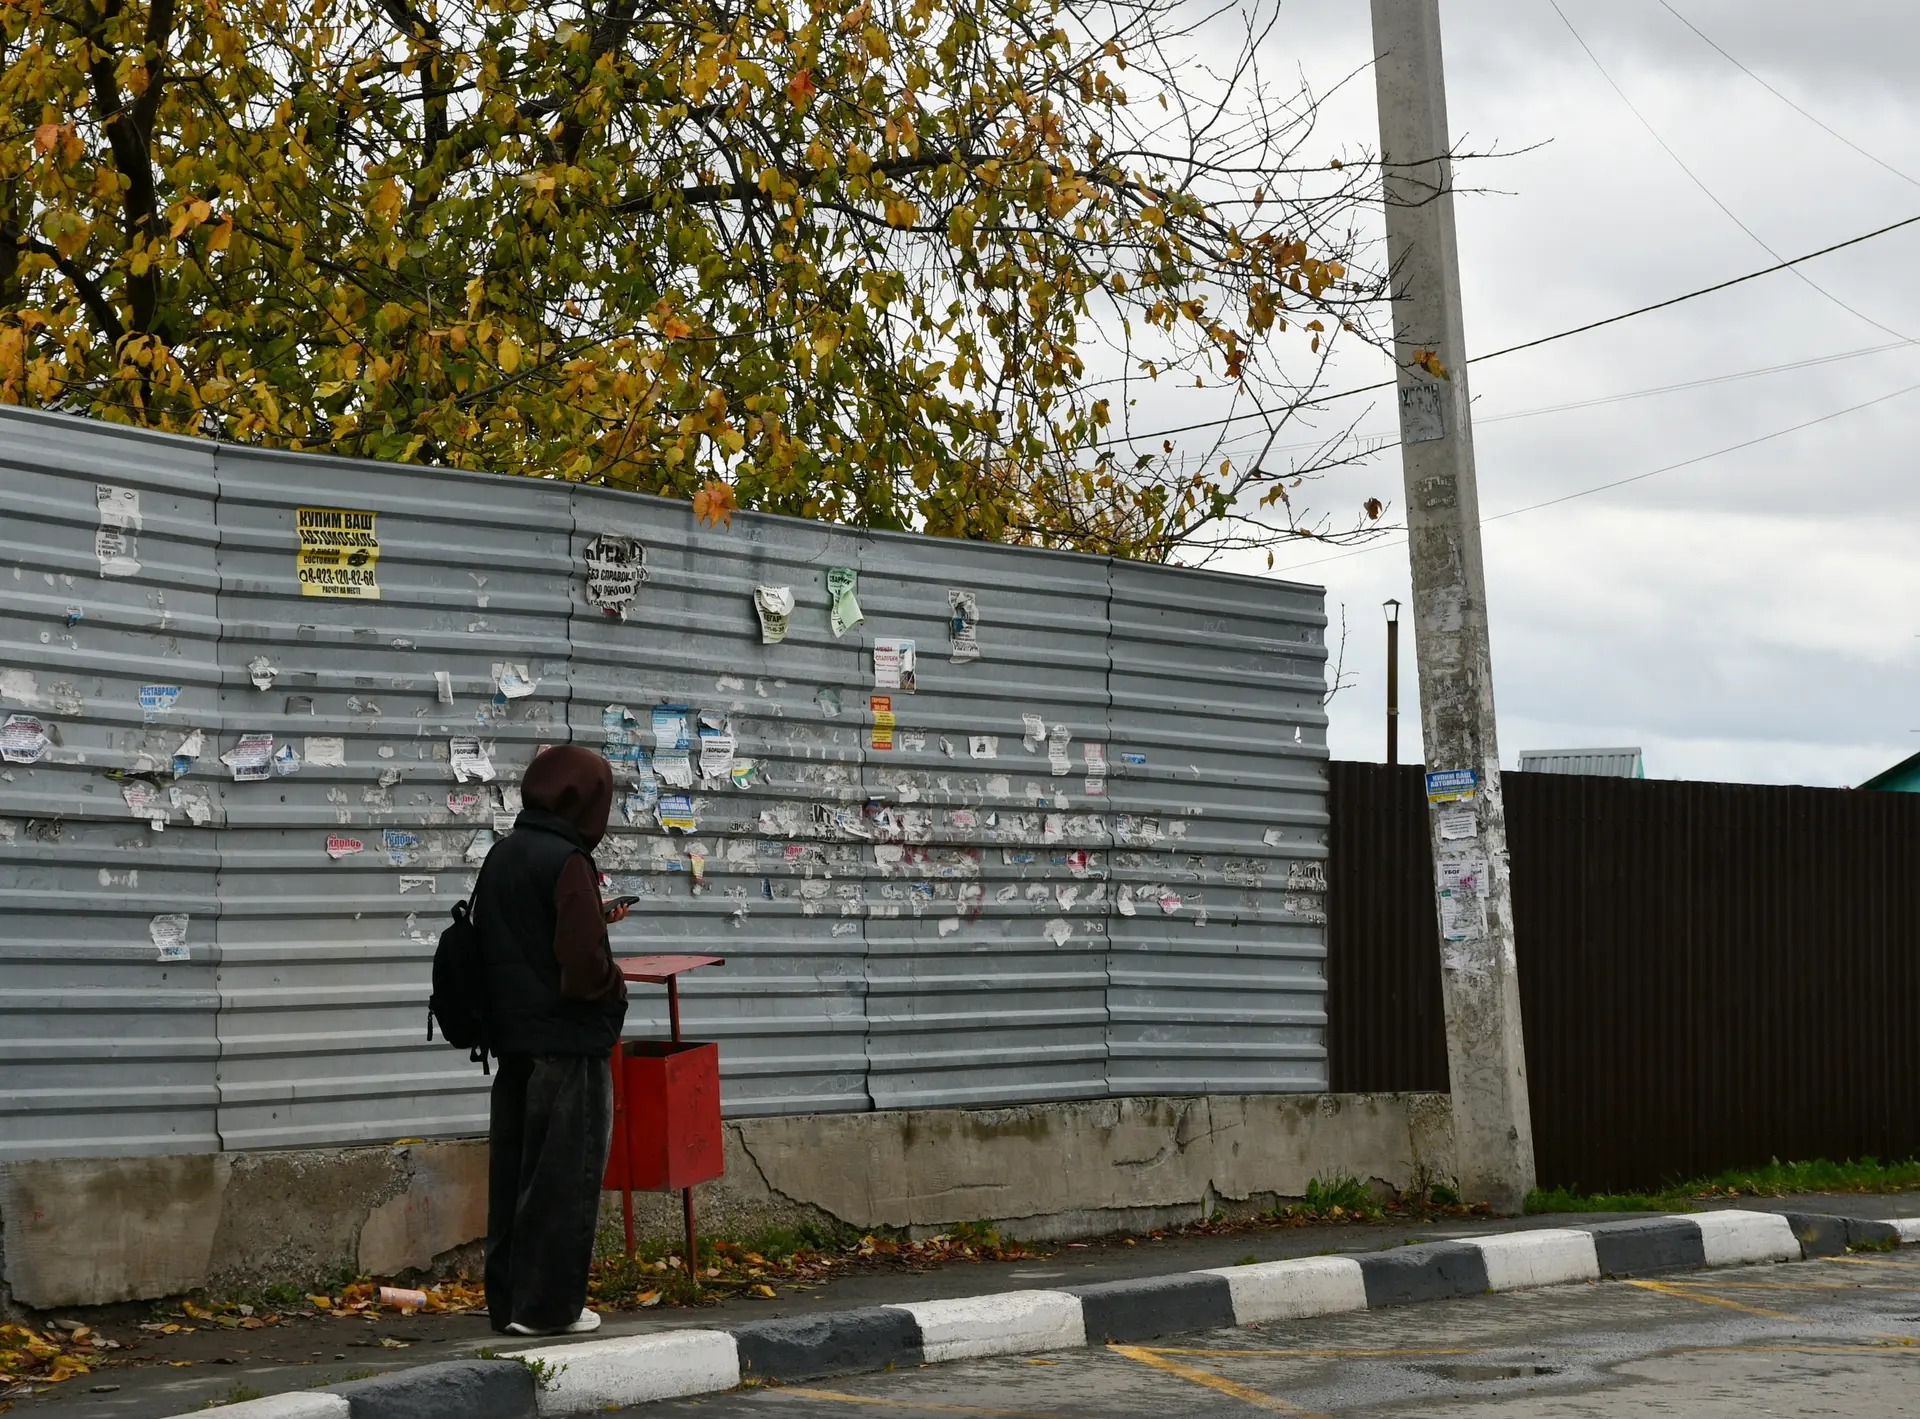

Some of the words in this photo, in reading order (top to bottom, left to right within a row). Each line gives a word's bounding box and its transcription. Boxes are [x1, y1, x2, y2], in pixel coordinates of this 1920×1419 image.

[300, 511, 341, 529] КУПИМ
[344, 513, 372, 530] ВАШ
[300, 530, 378, 547] АВТОМОБИЛЬ
